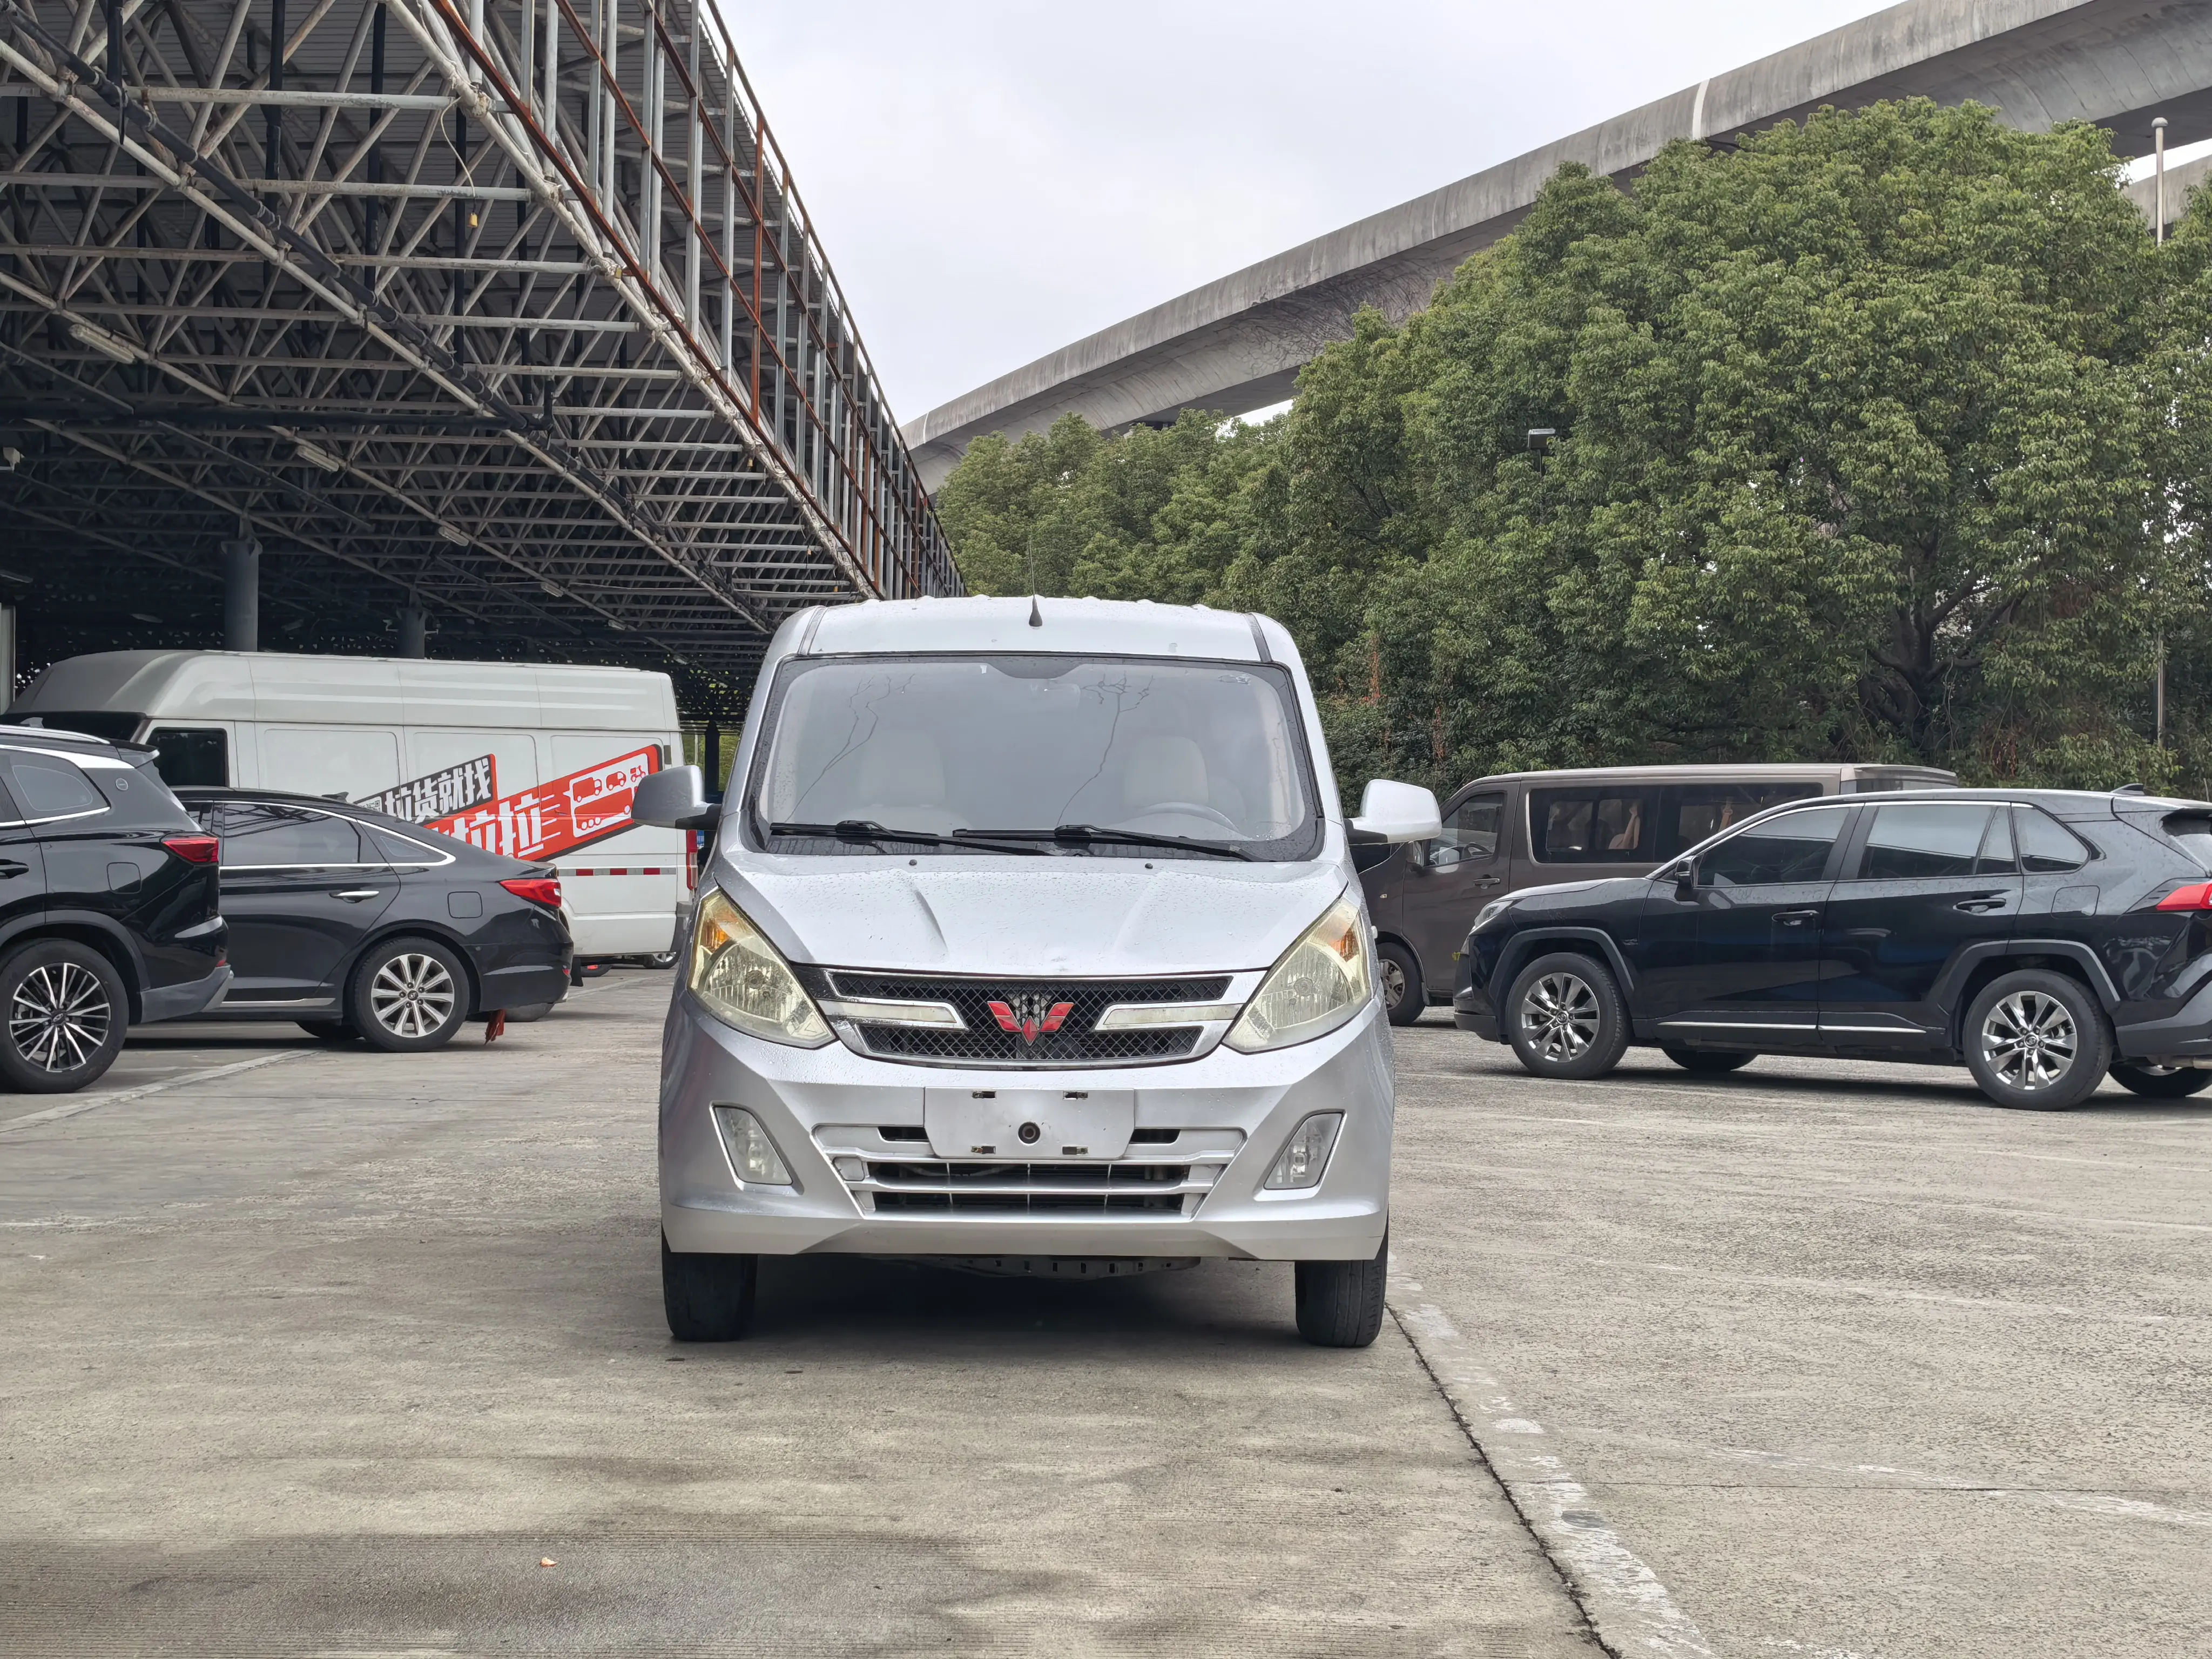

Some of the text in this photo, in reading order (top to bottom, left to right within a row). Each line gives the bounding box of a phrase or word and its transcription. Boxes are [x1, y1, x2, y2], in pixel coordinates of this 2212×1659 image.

[386, 758, 491, 824] 拉货就找
[431, 793, 544, 858] 拉拉
